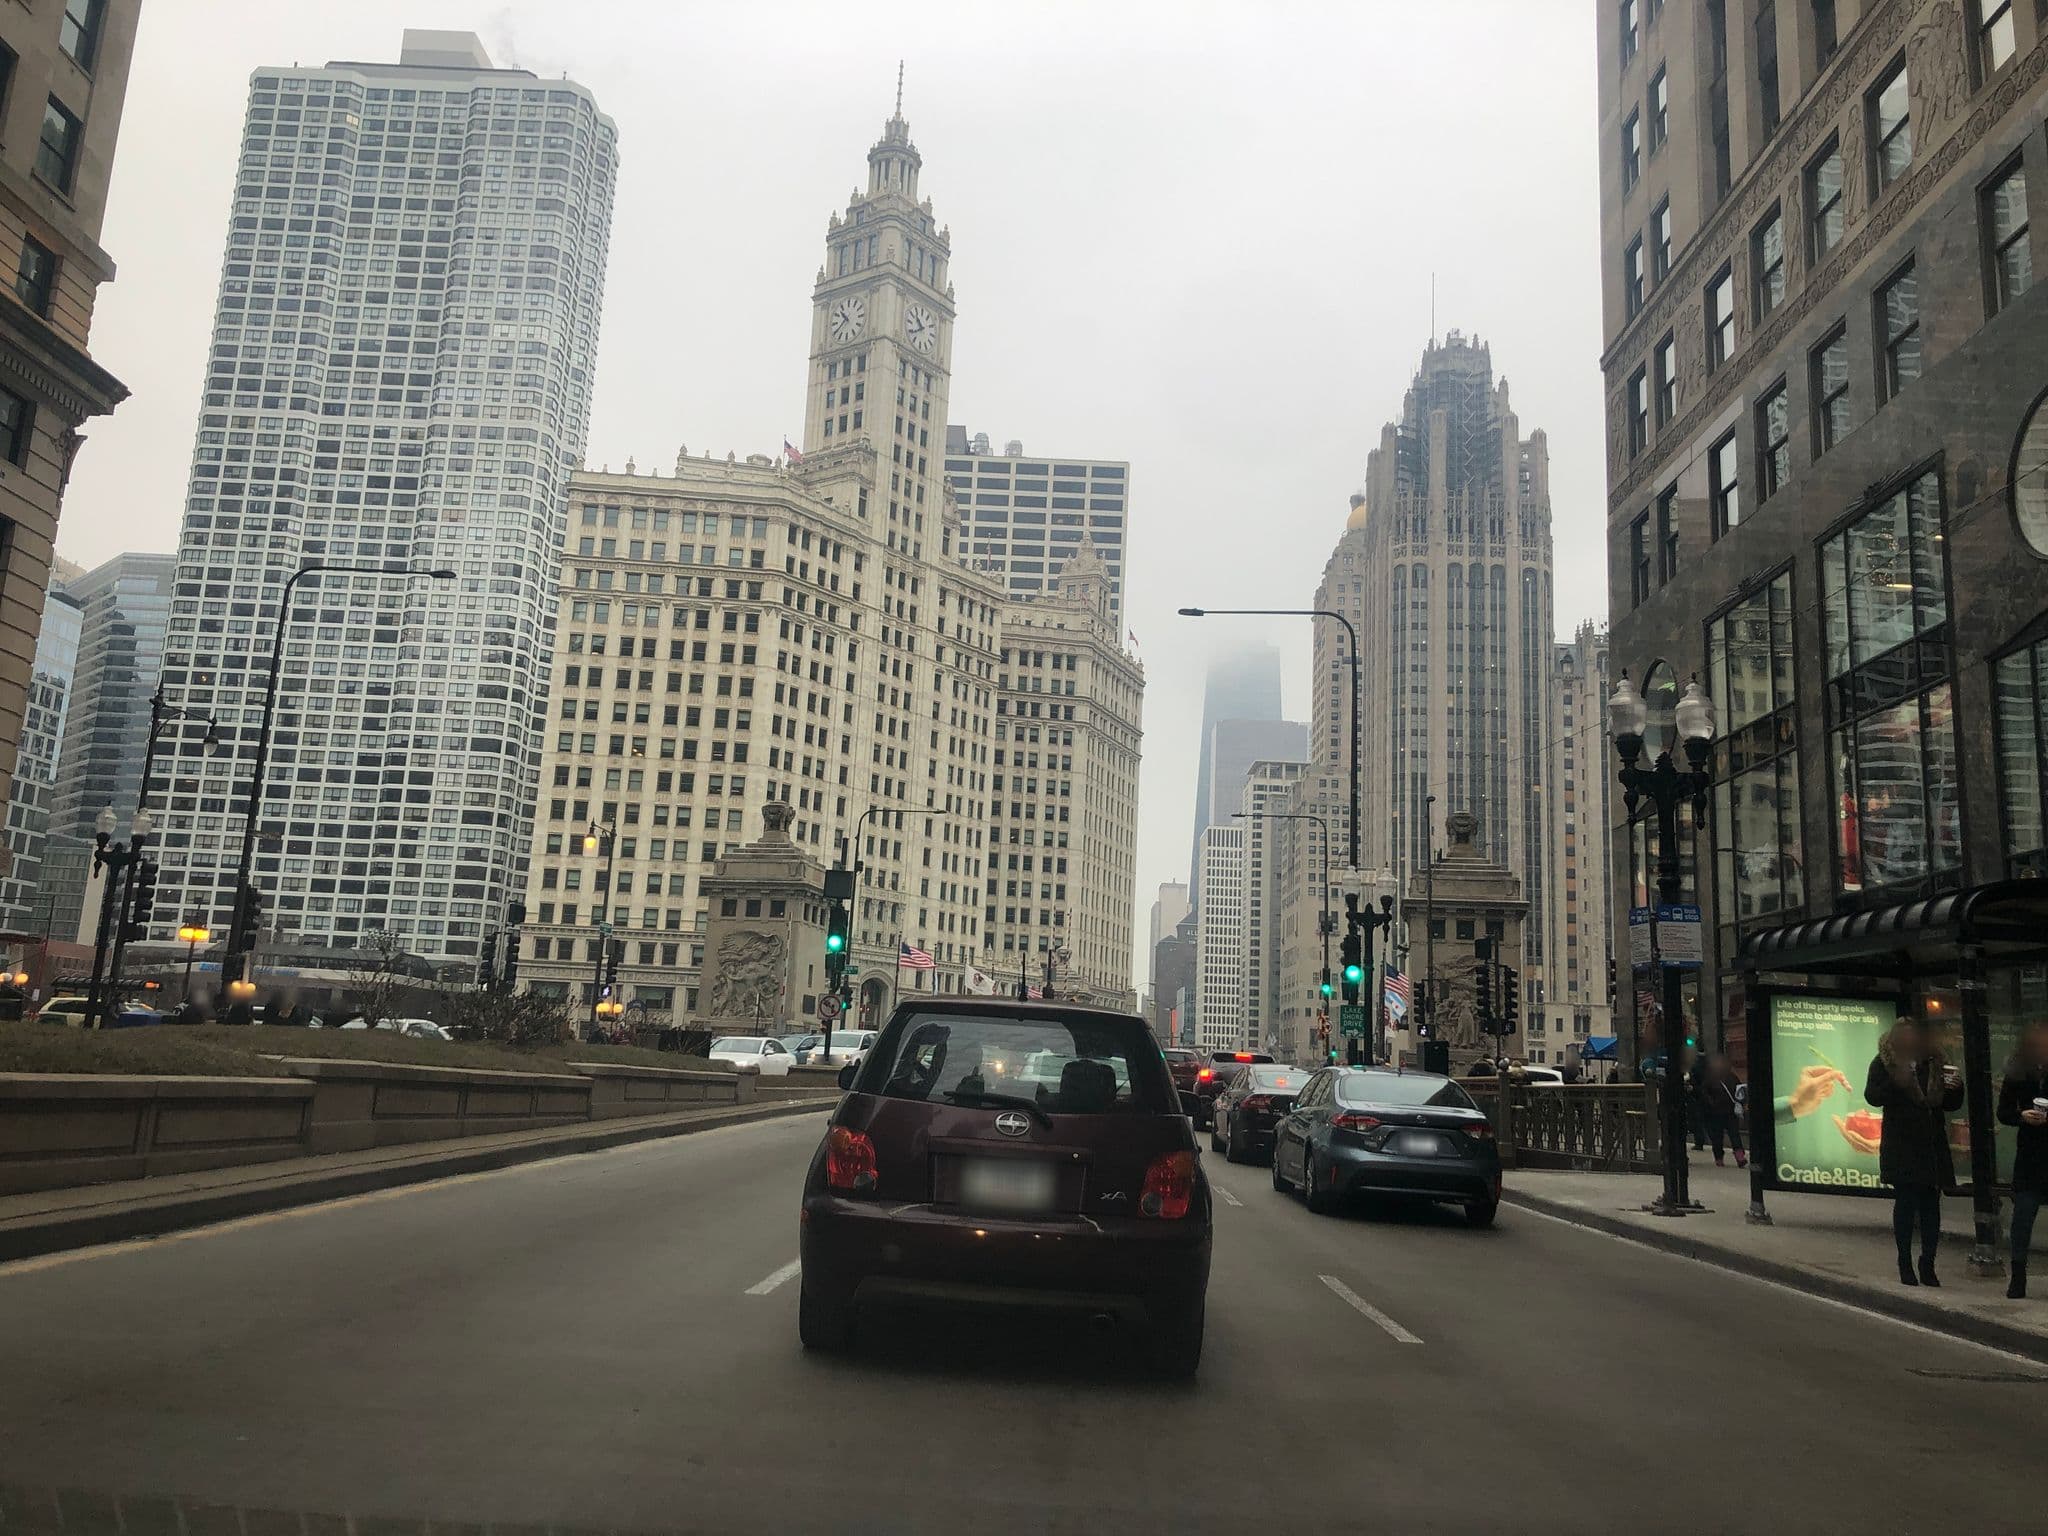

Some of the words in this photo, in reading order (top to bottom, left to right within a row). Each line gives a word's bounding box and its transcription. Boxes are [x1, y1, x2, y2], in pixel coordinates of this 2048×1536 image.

[1684, 913, 1700, 921] stop
[1777, 1000, 1792, 1008] Life
[1793, 1001, 1802, 1009] of
[1802, 1002, 1816, 1010] the
[1817, 1003, 1839, 1013] party
[1840, 1005, 1865, 1013] seeks
[1777, 1010, 1814, 1020] plus-one
[1814, 1012, 1823, 1020] to
[1823, 1013, 1848, 1022] shake
[1849, 1014, 1860, 1024] (or
[1777, 1019, 1803, 1029] things
[1803, 1022, 1815, 1031] up
[1778, 1163, 1895, 1189] Crate&Bar
